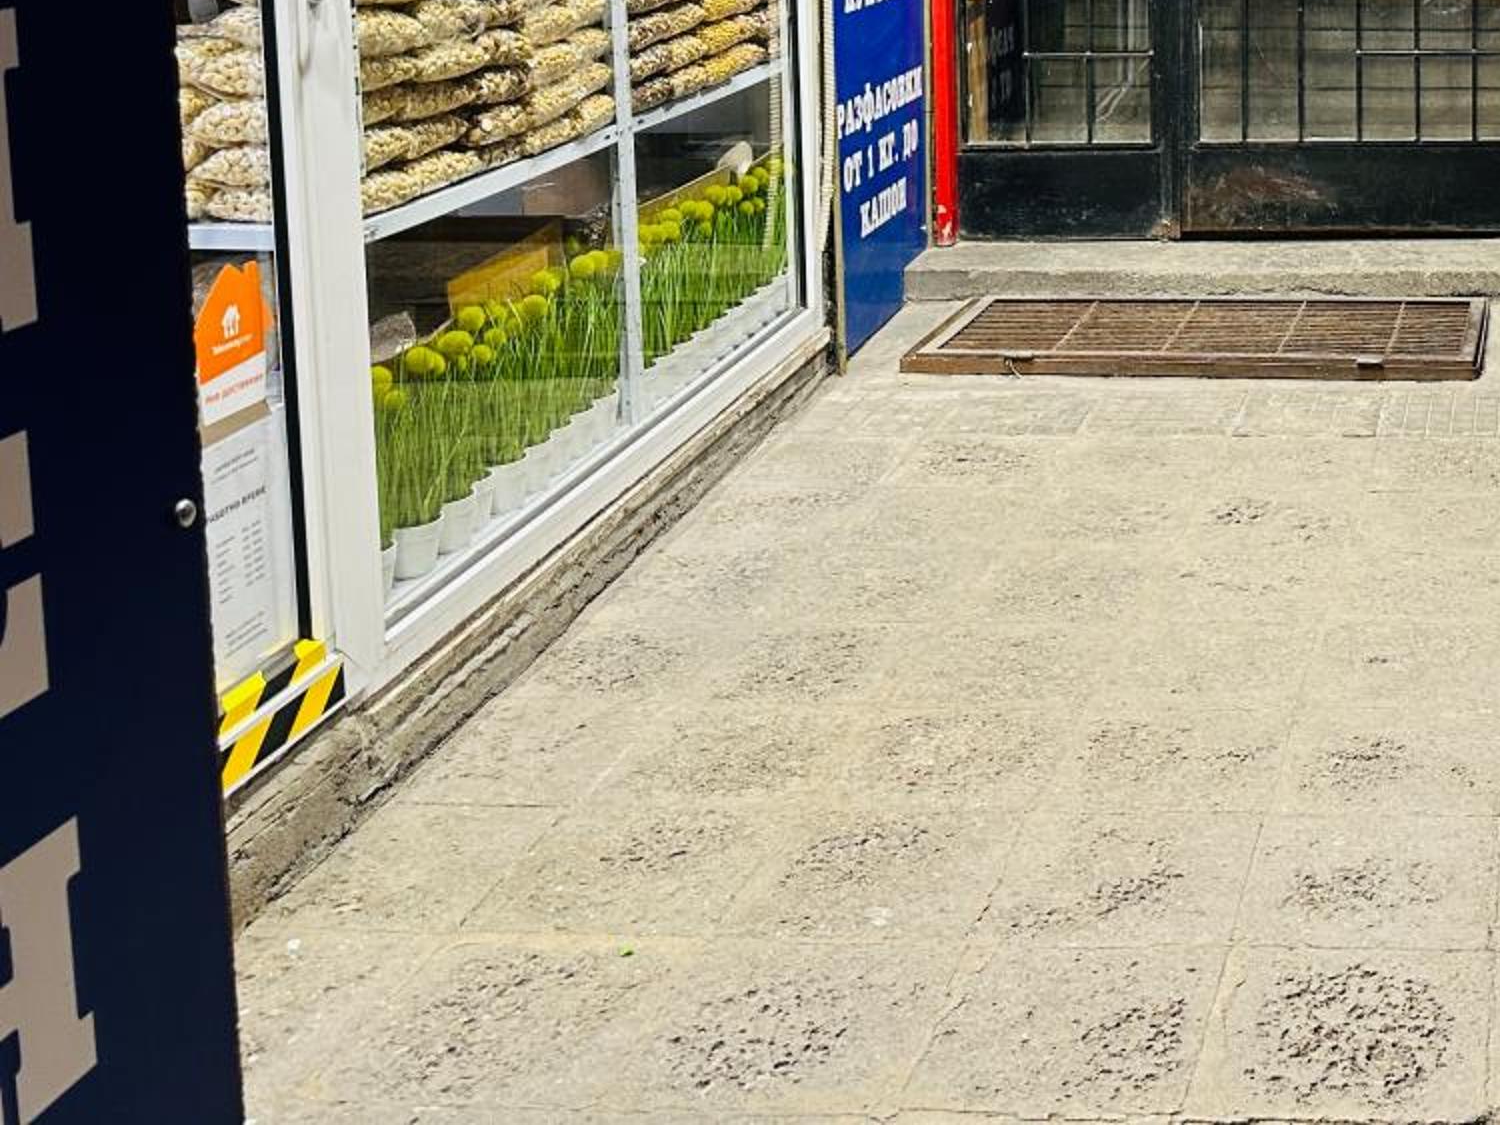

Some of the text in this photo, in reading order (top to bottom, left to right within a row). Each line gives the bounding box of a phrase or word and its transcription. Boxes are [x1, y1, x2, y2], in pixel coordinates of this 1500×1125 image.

[837, 65, 923, 140] РАЗФАСОВКИ
[843, 118, 919, 192] ОТ 1 КГ. ДО
[860, 176, 907, 239] КАШОН
